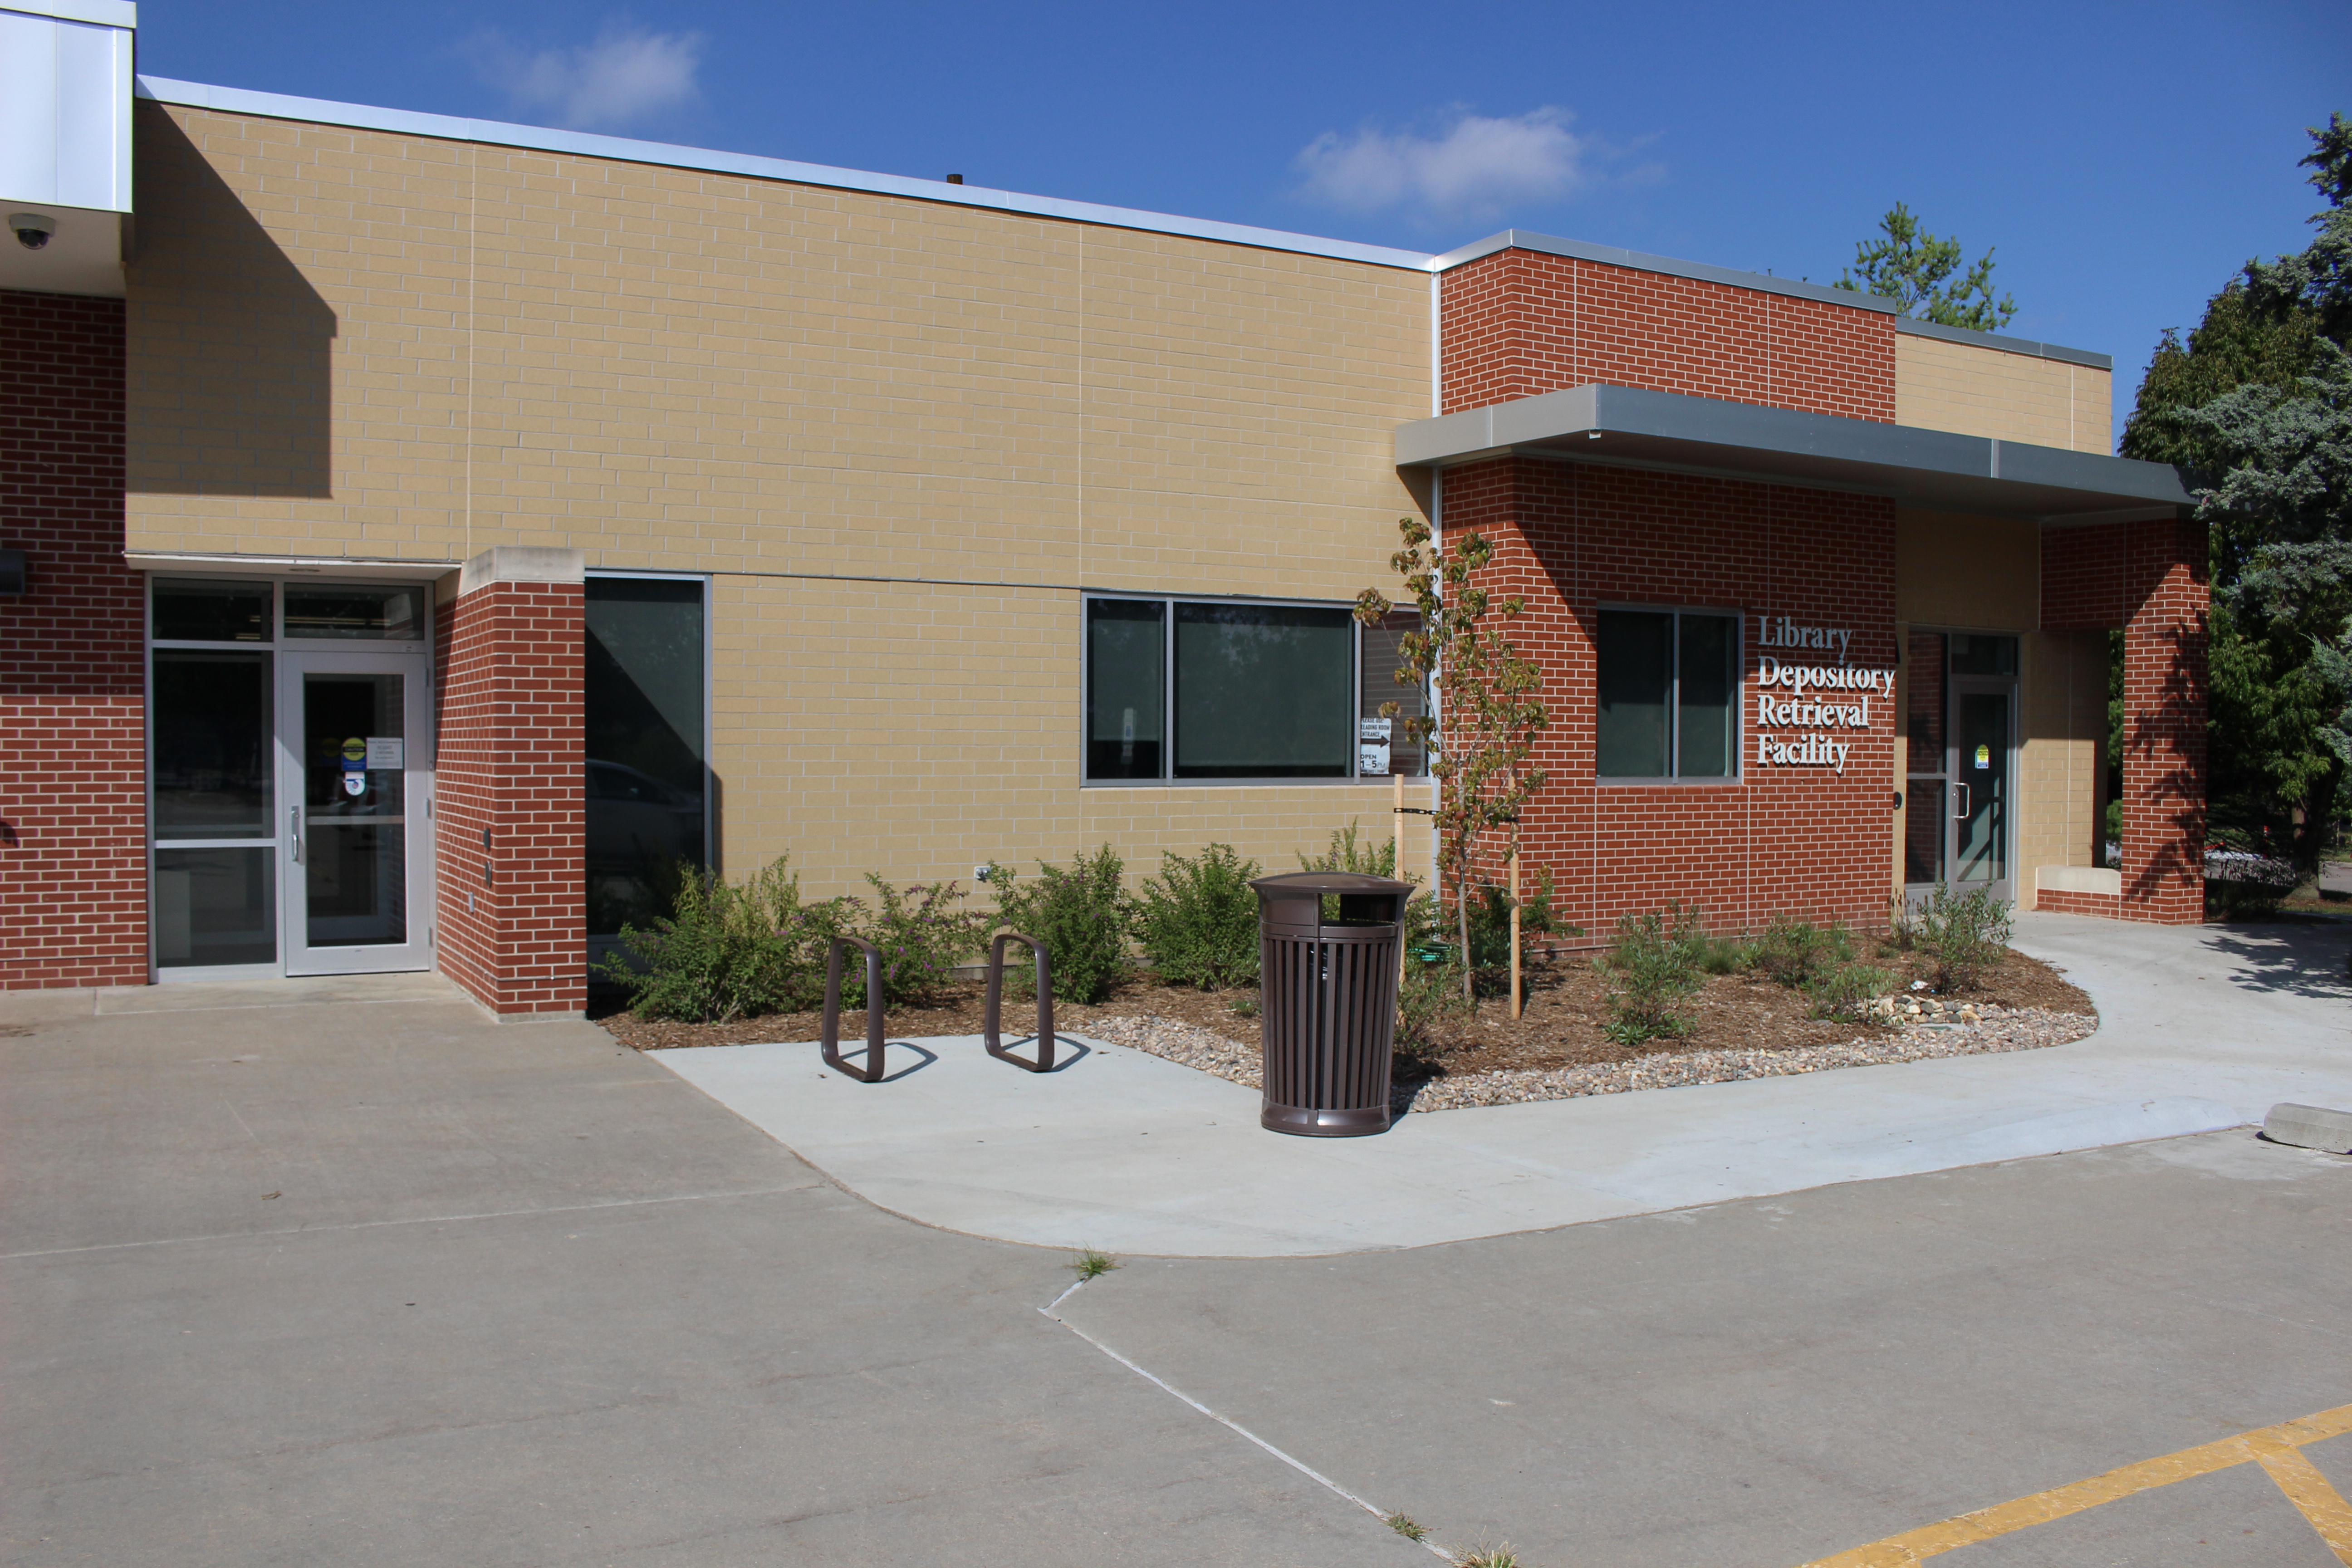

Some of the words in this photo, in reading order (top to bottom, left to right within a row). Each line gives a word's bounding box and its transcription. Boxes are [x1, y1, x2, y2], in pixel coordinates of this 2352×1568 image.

[1758, 616, 1852, 659] Library
[1758, 656, 1896, 699] Depository
[1757, 695, 1869, 726] Retrieval
[1757, 732, 1850, 774] Facility
